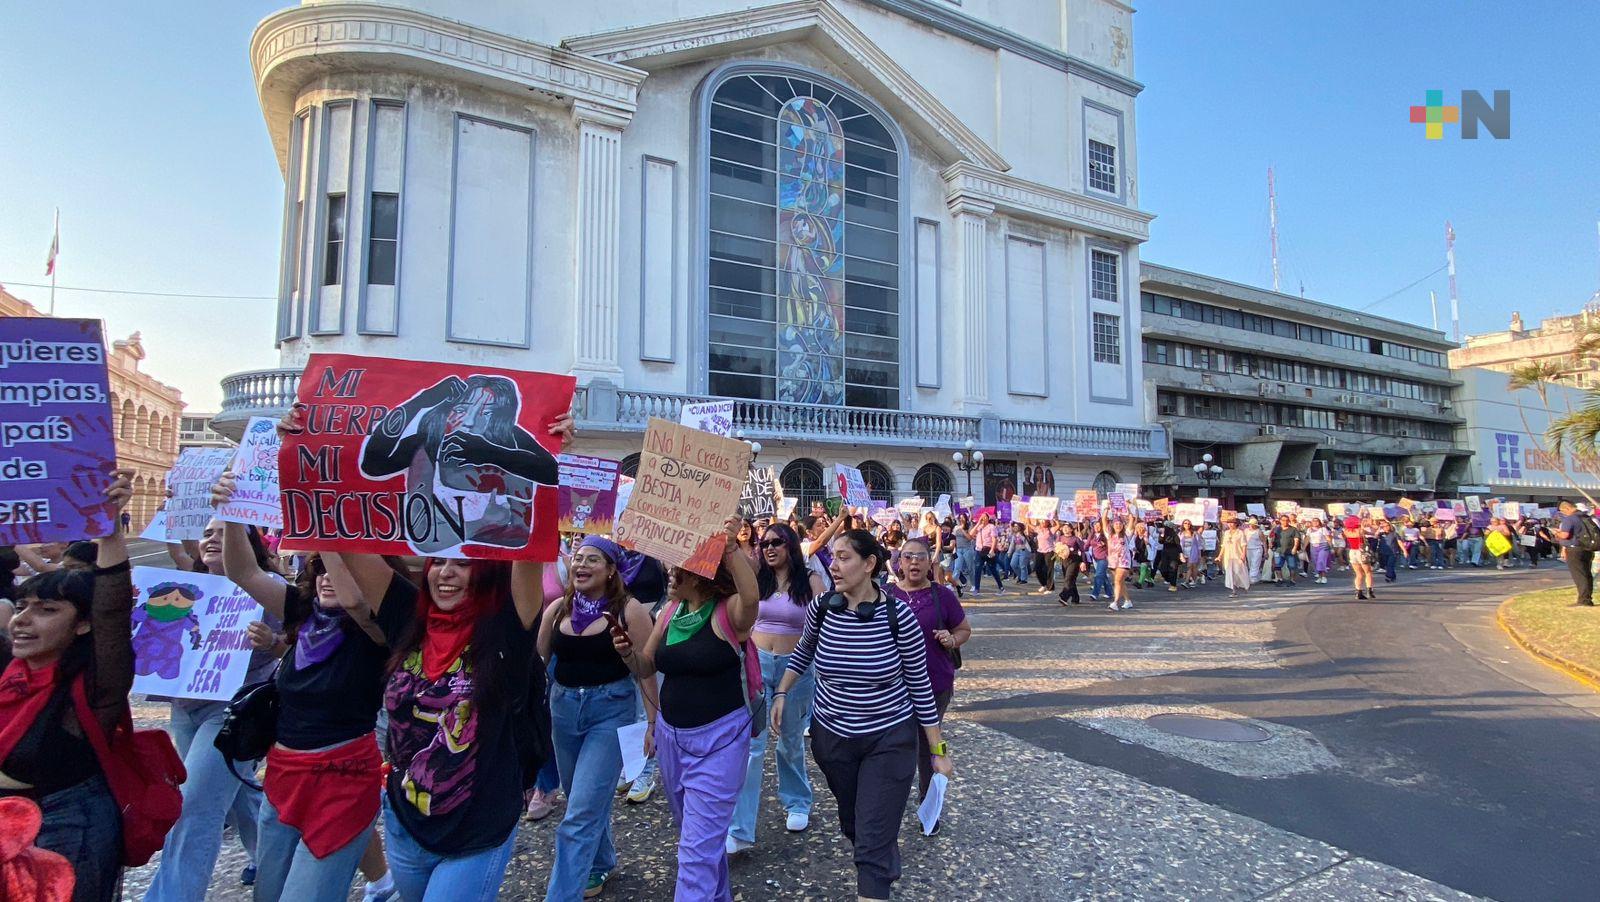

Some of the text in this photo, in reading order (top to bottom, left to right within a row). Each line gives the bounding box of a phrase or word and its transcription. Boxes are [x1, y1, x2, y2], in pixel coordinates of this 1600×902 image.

[0, 339, 98, 365] uieres
[314, 365, 366, 398] MI
[5, 416, 70, 446] país
[289, 403, 407, 437] CUERPO
[3, 458, 43, 479] de
[297, 444, 344, 484] MI
[697, 448, 729, 472] creas
[641, 474, 682, 504] BESTIA
[687, 495, 702, 509] no
[708, 501, 720, 514] se
[756, 482, 773, 496] DE
[221, 506, 258, 521] NUNCA
[281, 484, 467, 545] DECISIÓN
[751, 496, 775, 516] VIDA
